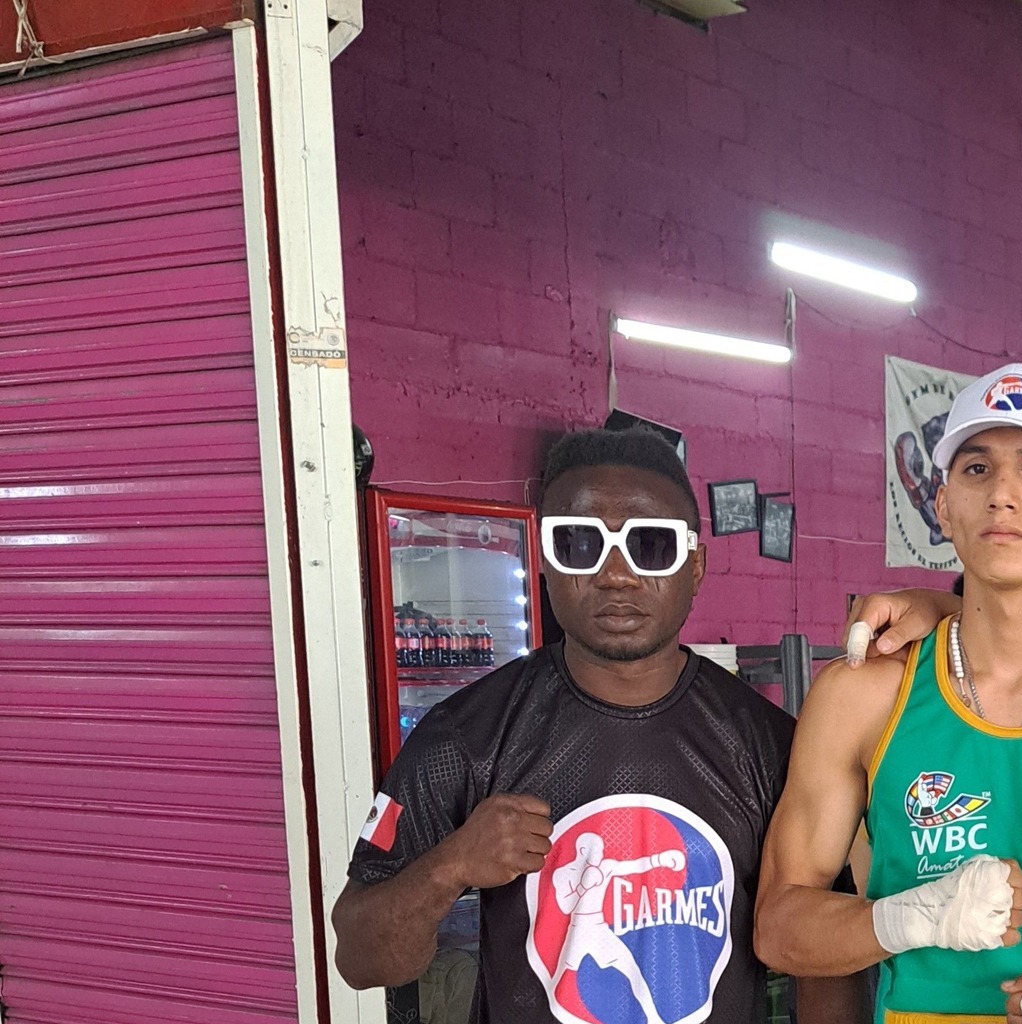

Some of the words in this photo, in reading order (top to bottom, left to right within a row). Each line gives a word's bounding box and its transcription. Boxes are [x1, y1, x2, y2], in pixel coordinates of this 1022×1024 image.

[912, 823, 987, 856] WBC
[917, 855, 964, 874] Amat
[613, 876, 725, 938] GARMES
